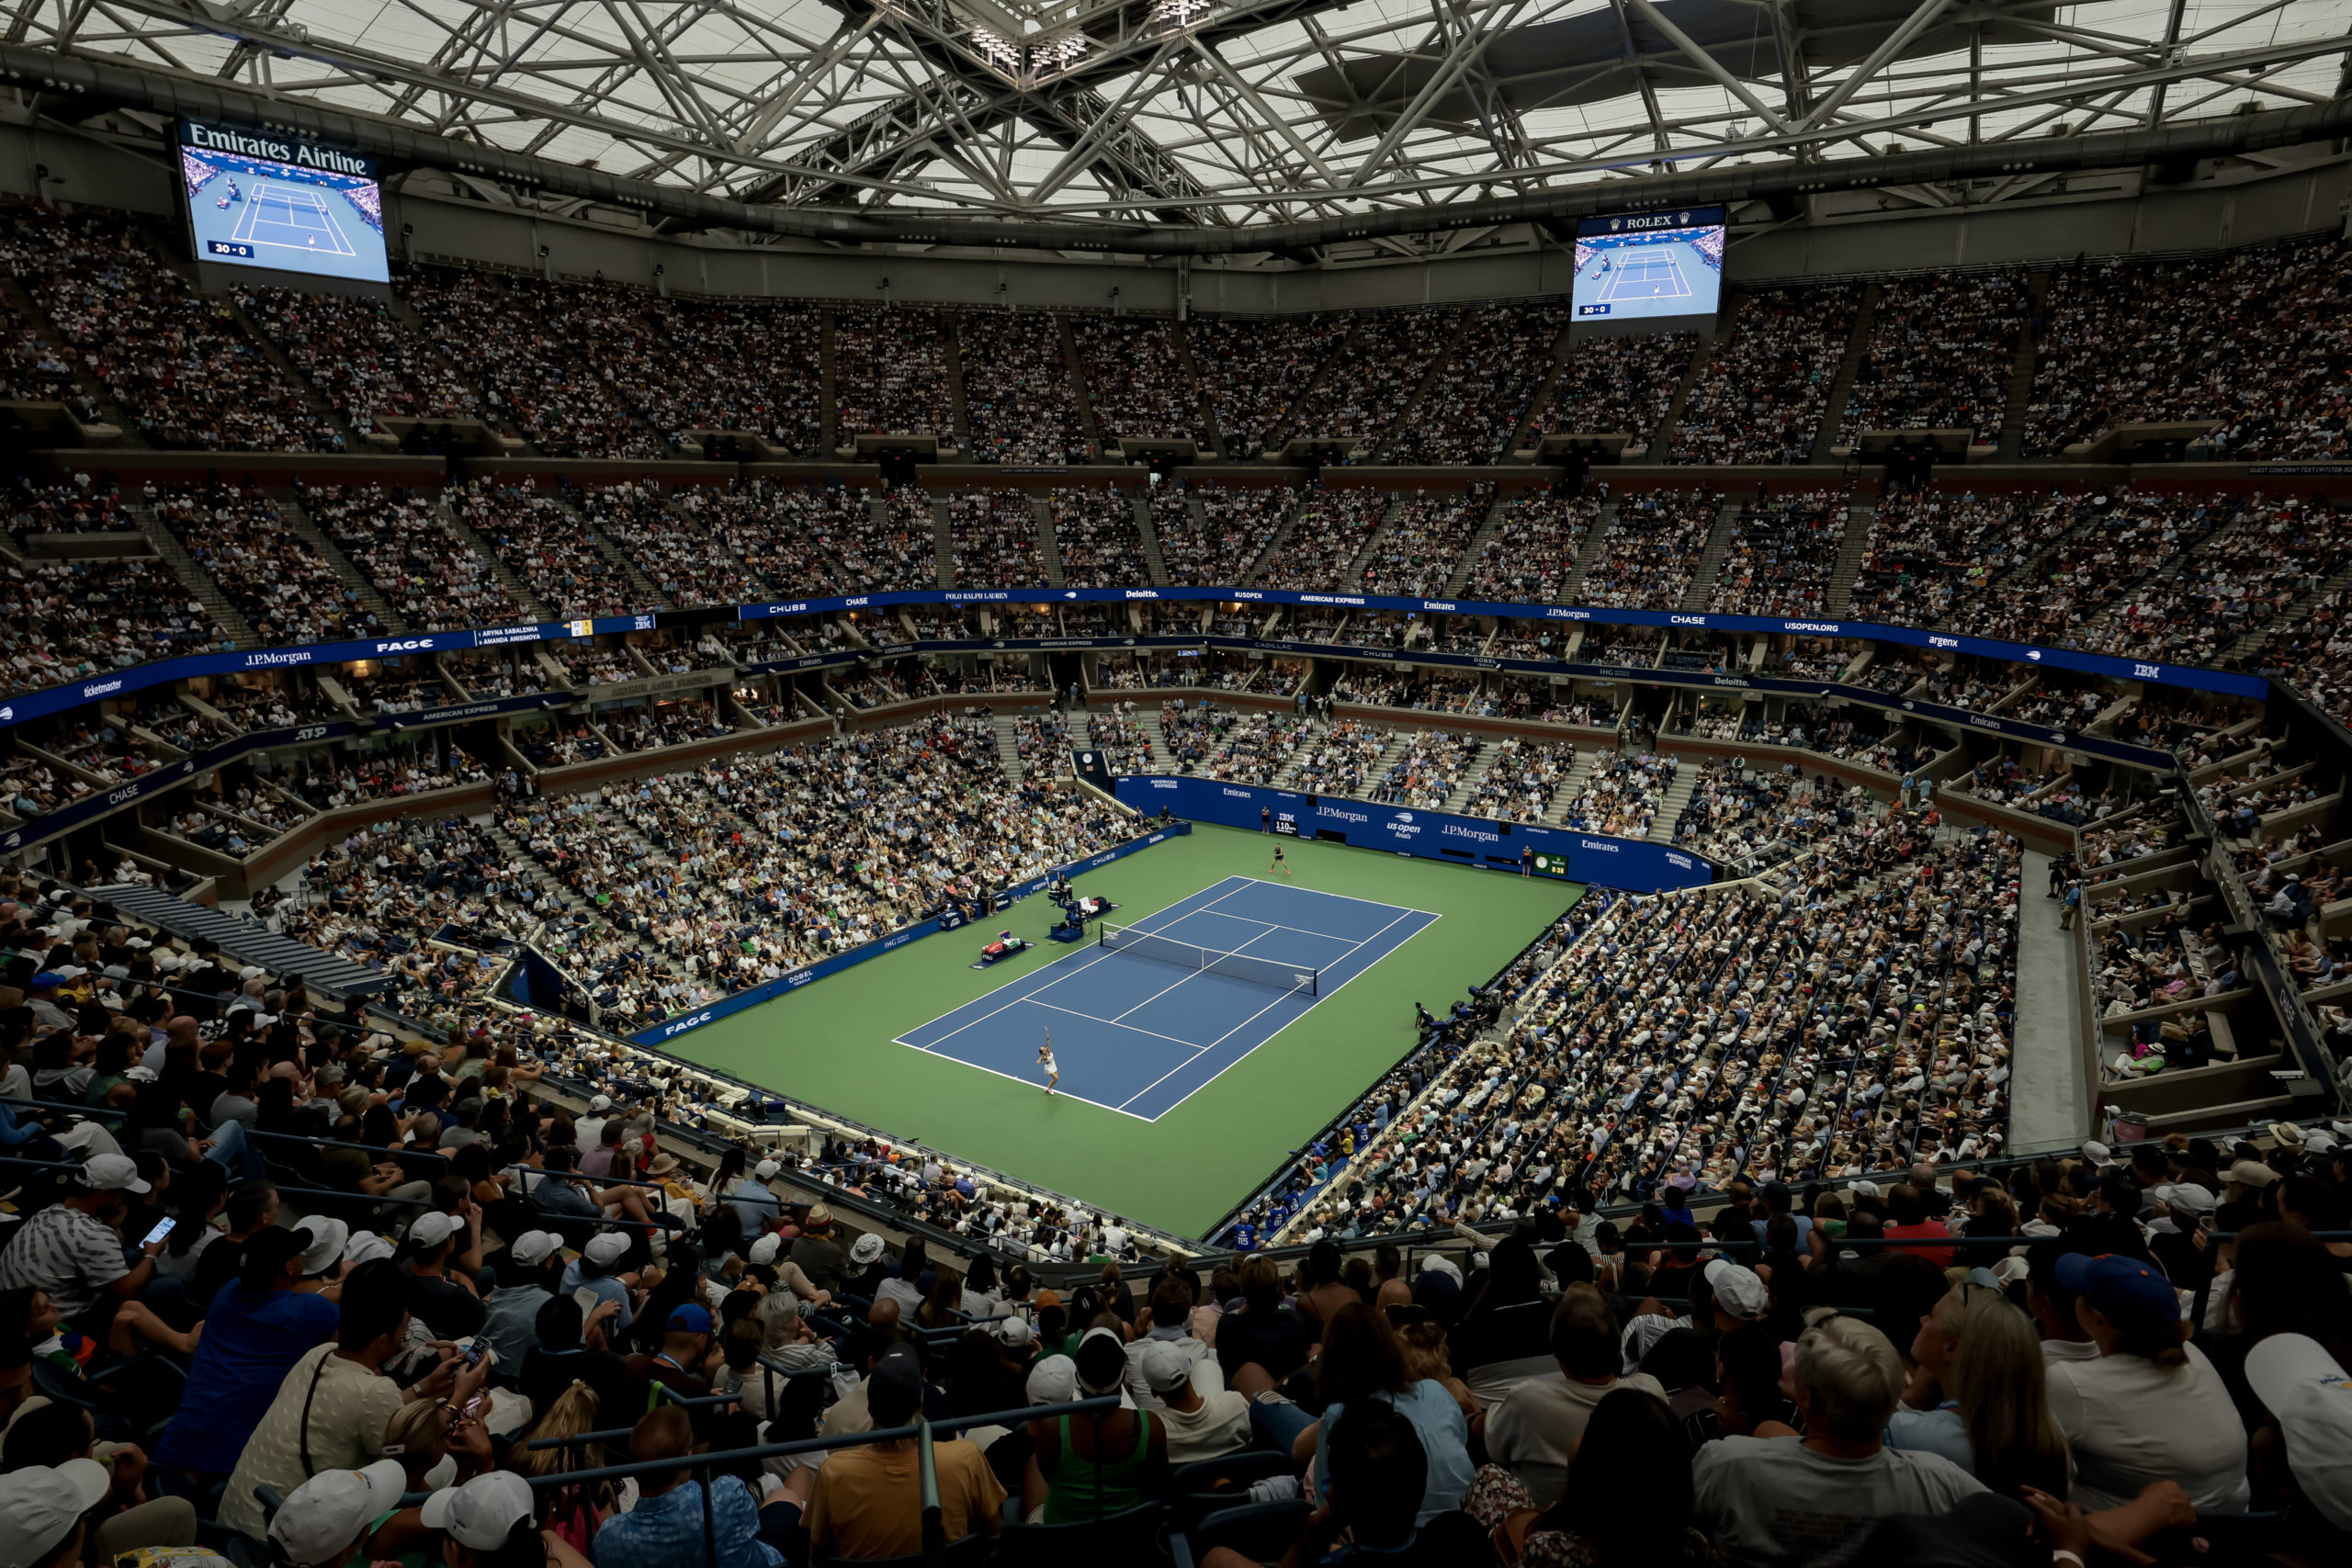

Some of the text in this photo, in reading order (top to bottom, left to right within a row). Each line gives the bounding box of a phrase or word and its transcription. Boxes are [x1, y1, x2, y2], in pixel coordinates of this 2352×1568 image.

[189, 122, 367, 175] Emirates Airline
[1626, 215, 1672, 229] ROLEX
[215, 243, 230, 254] 30
[239, 246, 246, 255] 0
[1584, 306, 1594, 314] 30
[1600, 305, 1606, 313] 0
[1125, 590, 1159, 598] Deloitte.
[1300, 594, 1333, 603] AMERICAN
[845, 596, 868, 606] CHASE
[1424, 601, 1455, 611] Emirates
[769, 603, 807, 615] CHUBB
[1546, 608, 1590, 620] J.P.Morgan
[635, 620, 651, 630] IBM
[1670, 615, 1706, 626] CHASE
[503, 626, 538, 635] SABALENKA
[1784, 621, 1838, 633] USOPEN.ORG
[483, 637, 508, 645] AMANDA
[509, 633, 540, 642] ANISIMOVA
[1928, 636, 1959, 649] argenx
[884, 644, 913, 655] USOPEN.ORG
[1254, 642, 1293, 650] CADILLAC
[245, 650, 311, 667] J.P.Morgan
[1363, 650, 1394, 659] CHUBB
[798, 658, 822, 668] Emirates
[2134, 663, 2160, 679] IBM
[1714, 677, 1750, 687] Deloitte.
[84, 679, 122, 698] ticketmaster
[423, 705, 498, 721] AMERICAN EXPRESS
[1970, 715, 2001, 729] Emirates
[295, 726, 327, 741] ATP
[109, 784, 139, 806] CHASE
[1223, 787, 1251, 799] Emirates
[1279, 812, 1295, 822] IBM
[1317, 807, 1368, 823] J.P.Morgan
[1275, 821, 1290, 830] 110
[1386, 822, 1421, 834] us open
[1395, 831, 1411, 840] finals
[1442, 824, 1498, 842] J.P.Morgan
[1582, 840, 1619, 852] Emirates
[1092, 852, 1116, 866] CHUBB
[1666, 852, 1692, 864] AMERICAN
[1668, 857, 1692, 870] EXPRESS
[884, 939, 897, 949] IHG
[788, 970, 813, 984] DOBEL
[1238, 1237, 1249, 1246] 115
